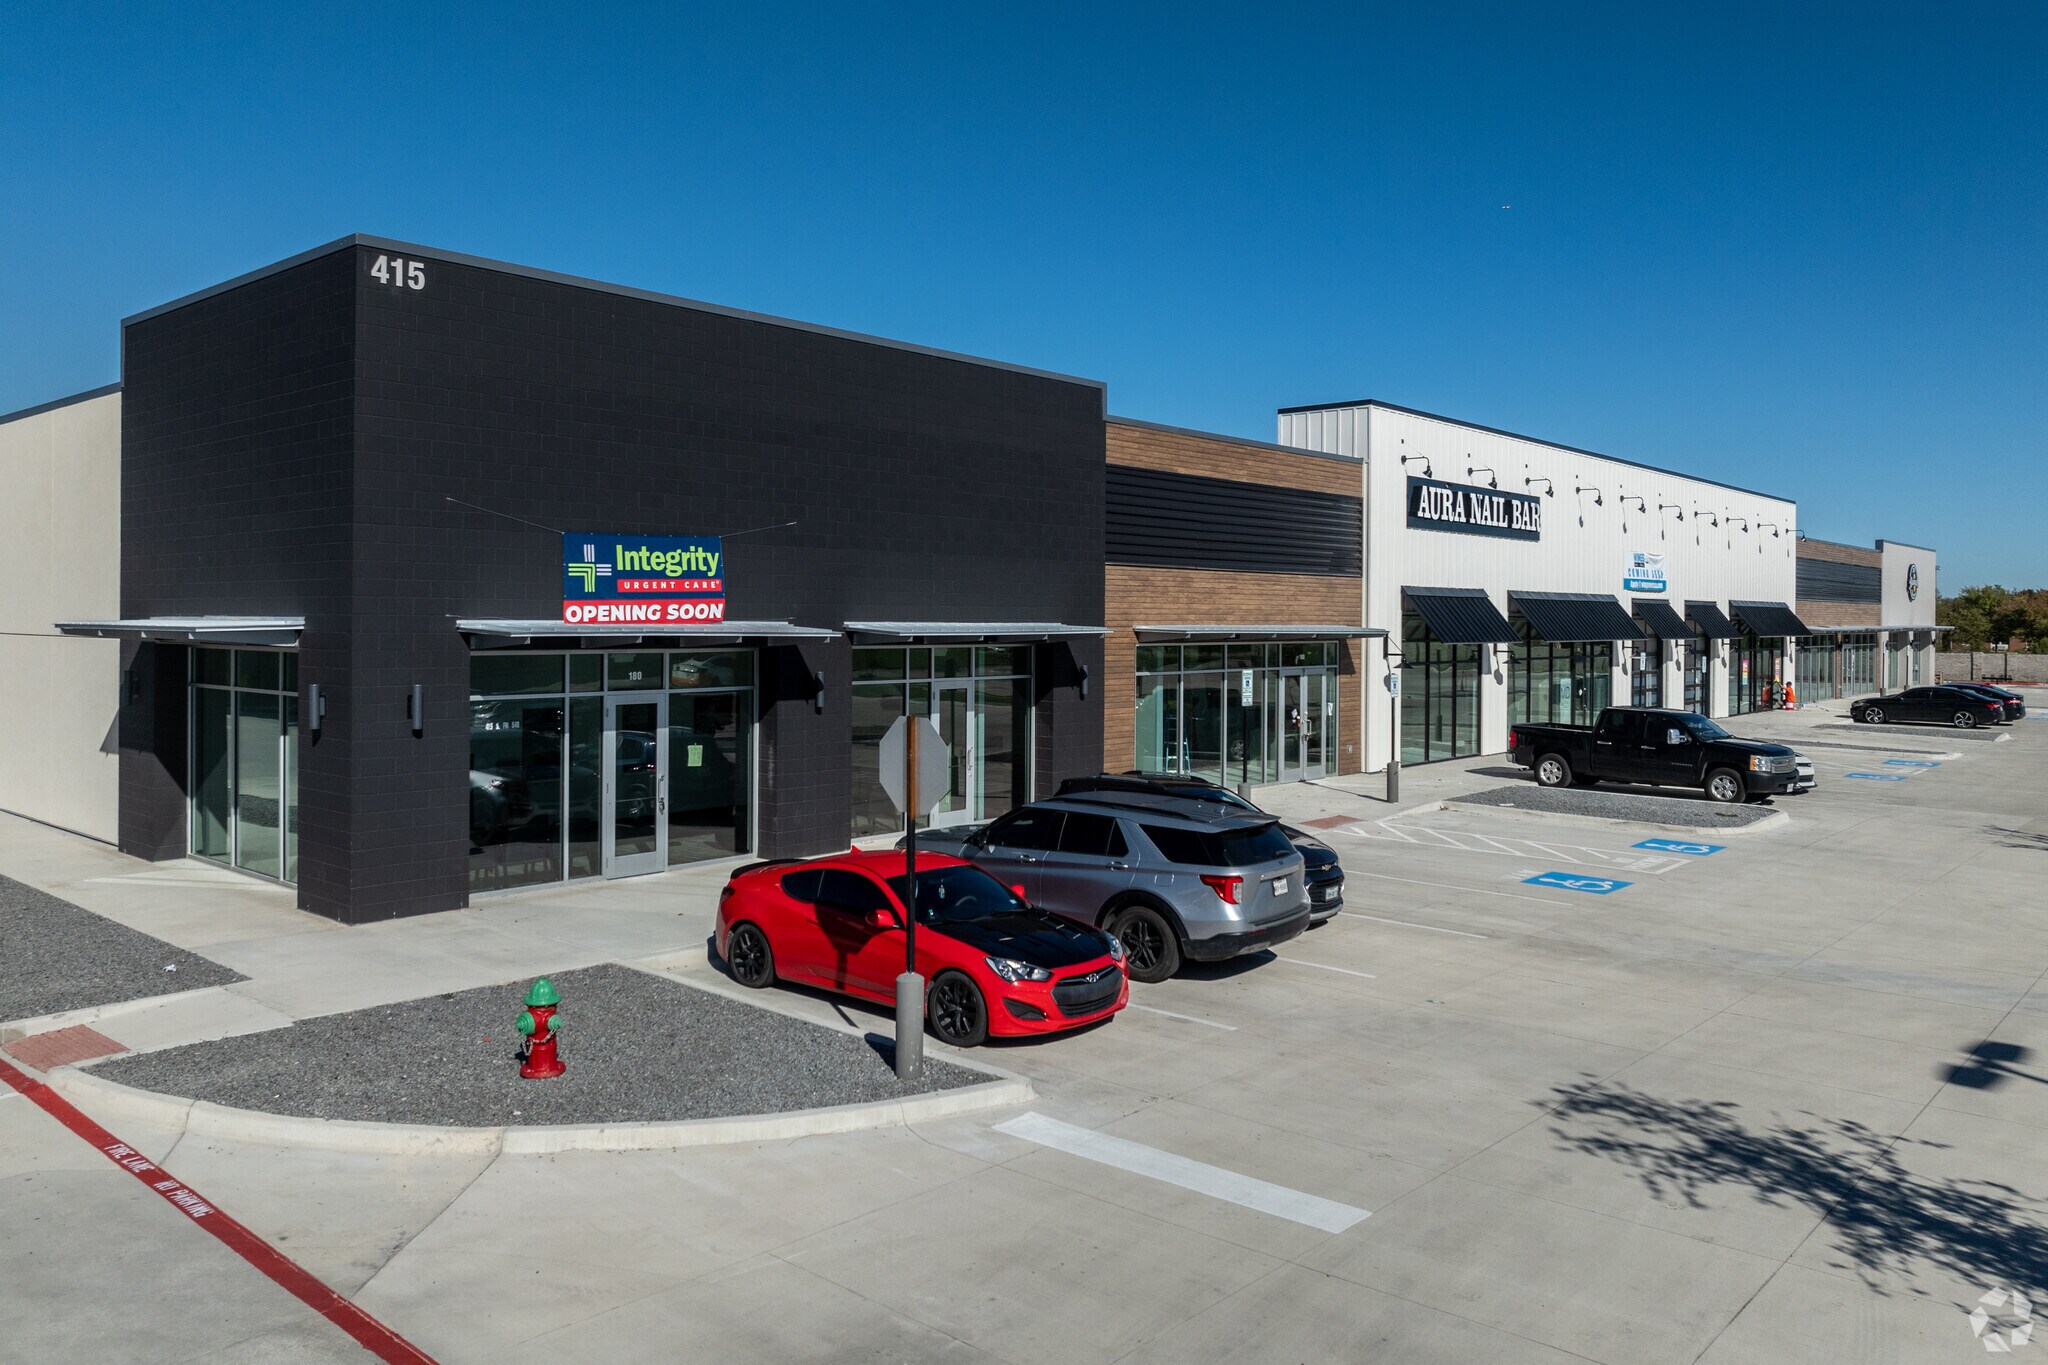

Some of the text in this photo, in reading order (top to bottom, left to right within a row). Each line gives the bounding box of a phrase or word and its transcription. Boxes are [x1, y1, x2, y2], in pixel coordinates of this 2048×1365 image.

[371, 255, 426, 290] 415
[1417, 485, 1541, 533] AURA NAIL BAR
[616, 544, 720, 577] Integrity
[623, 581, 676, 590] URGENT
[565, 603, 724, 623] OPENING SOON
[628, 671, 643, 681] 180
[153, 1179, 215, 1218] NO PARKING
